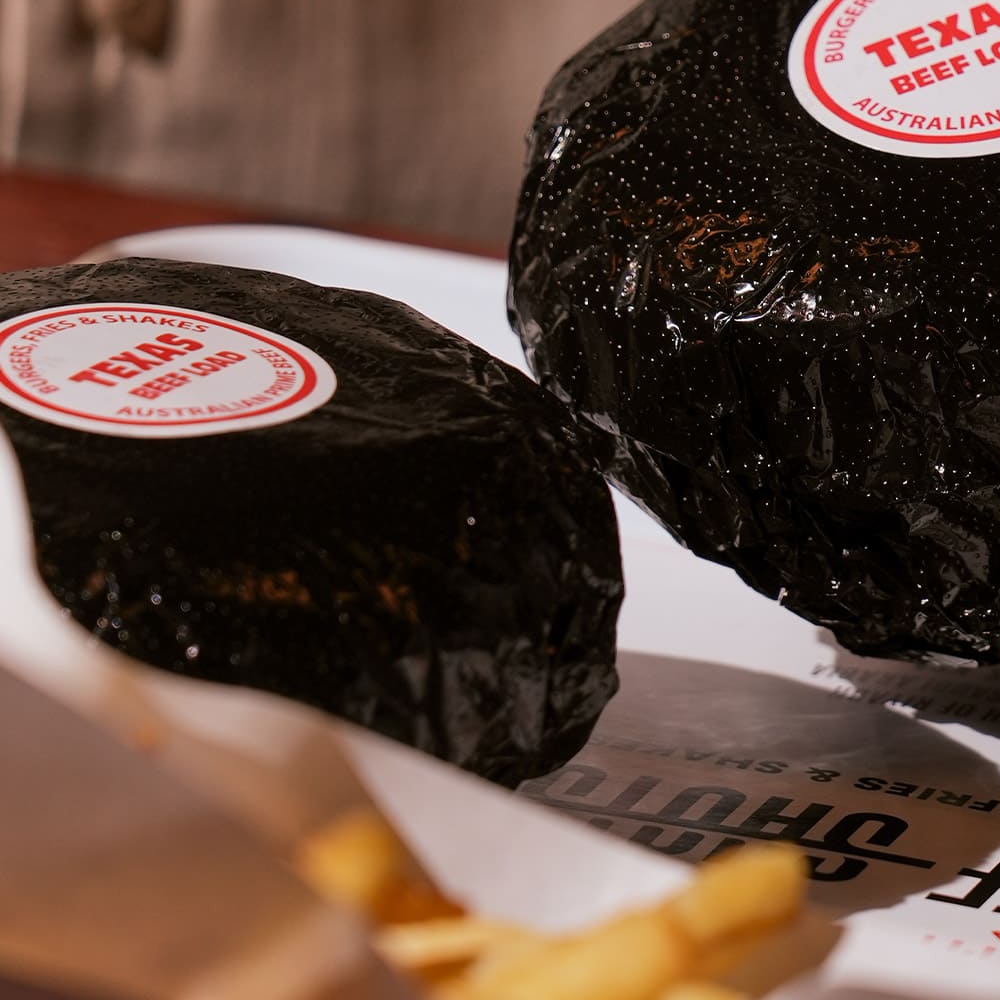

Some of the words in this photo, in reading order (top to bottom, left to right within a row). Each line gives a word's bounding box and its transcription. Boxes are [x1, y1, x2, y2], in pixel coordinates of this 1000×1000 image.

[890, 54, 970, 95] BEEF
[21, 319, 77, 346] FRIES
[79, 315, 98, 325] &
[101, 313, 210, 334] SHAKES
[69, 332, 204, 388] TEXAS
[128, 372, 193, 400] BEEF
[181, 350, 247, 378] LOAD
[116, 393, 272, 418] AUSTRALIAN
[265, 369, 297, 399] PRIME
[808, 766, 841, 783] &
[853, 775, 1000, 813] FRIES
